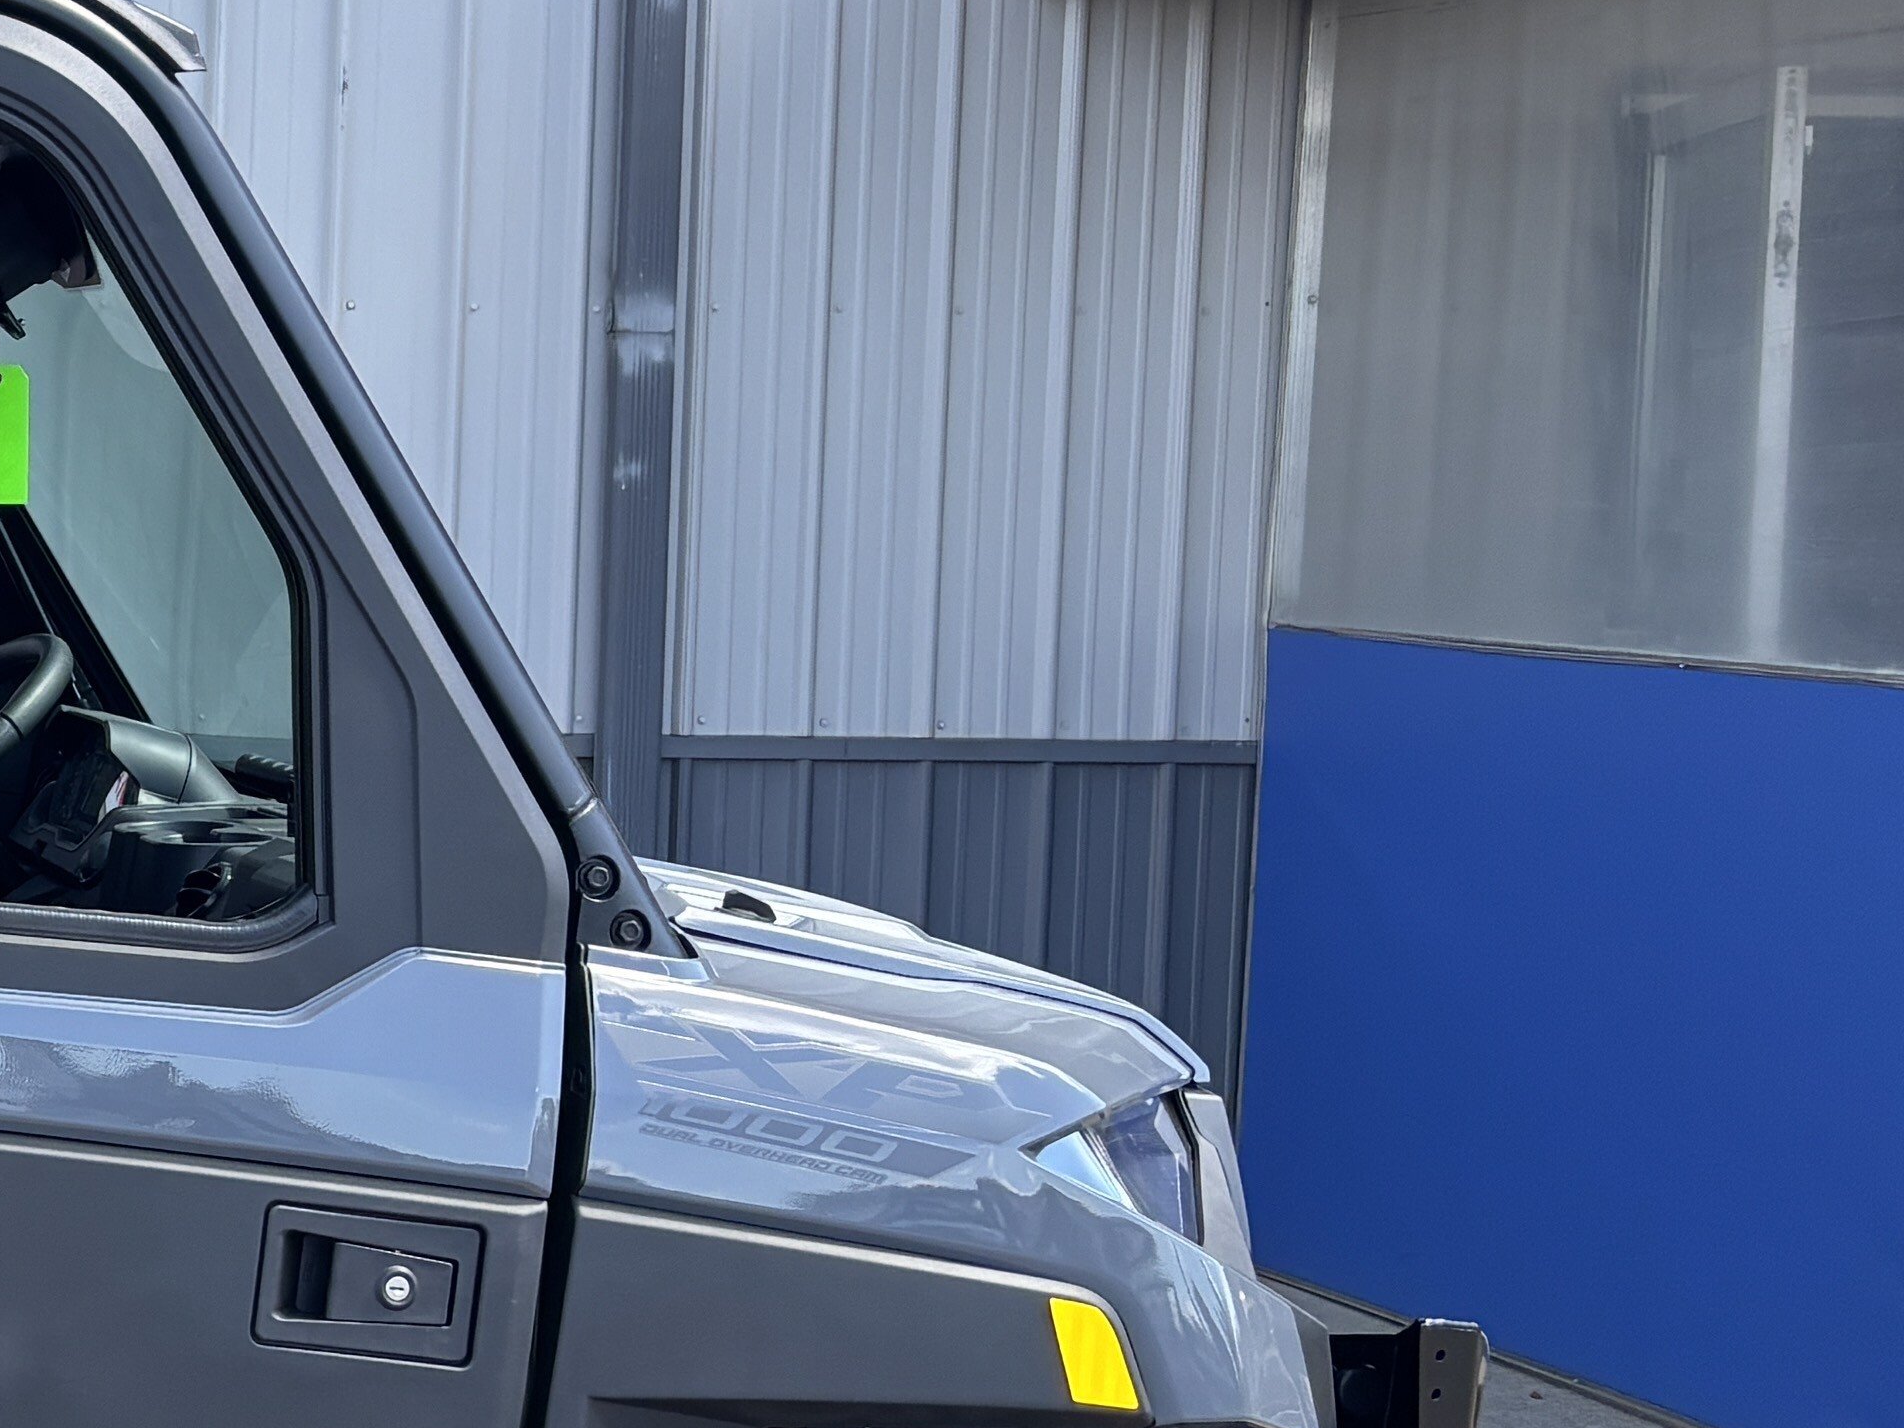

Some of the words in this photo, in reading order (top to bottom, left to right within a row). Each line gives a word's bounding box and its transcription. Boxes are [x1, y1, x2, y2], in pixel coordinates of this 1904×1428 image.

[635, 1016, 1002, 1112] XP
[637, 1096, 898, 1164] 1000
[638, 1123, 704, 1145] DUAL
[707, 1135, 831, 1173] OVERHEAD
[834, 1162, 890, 1184] CAM
